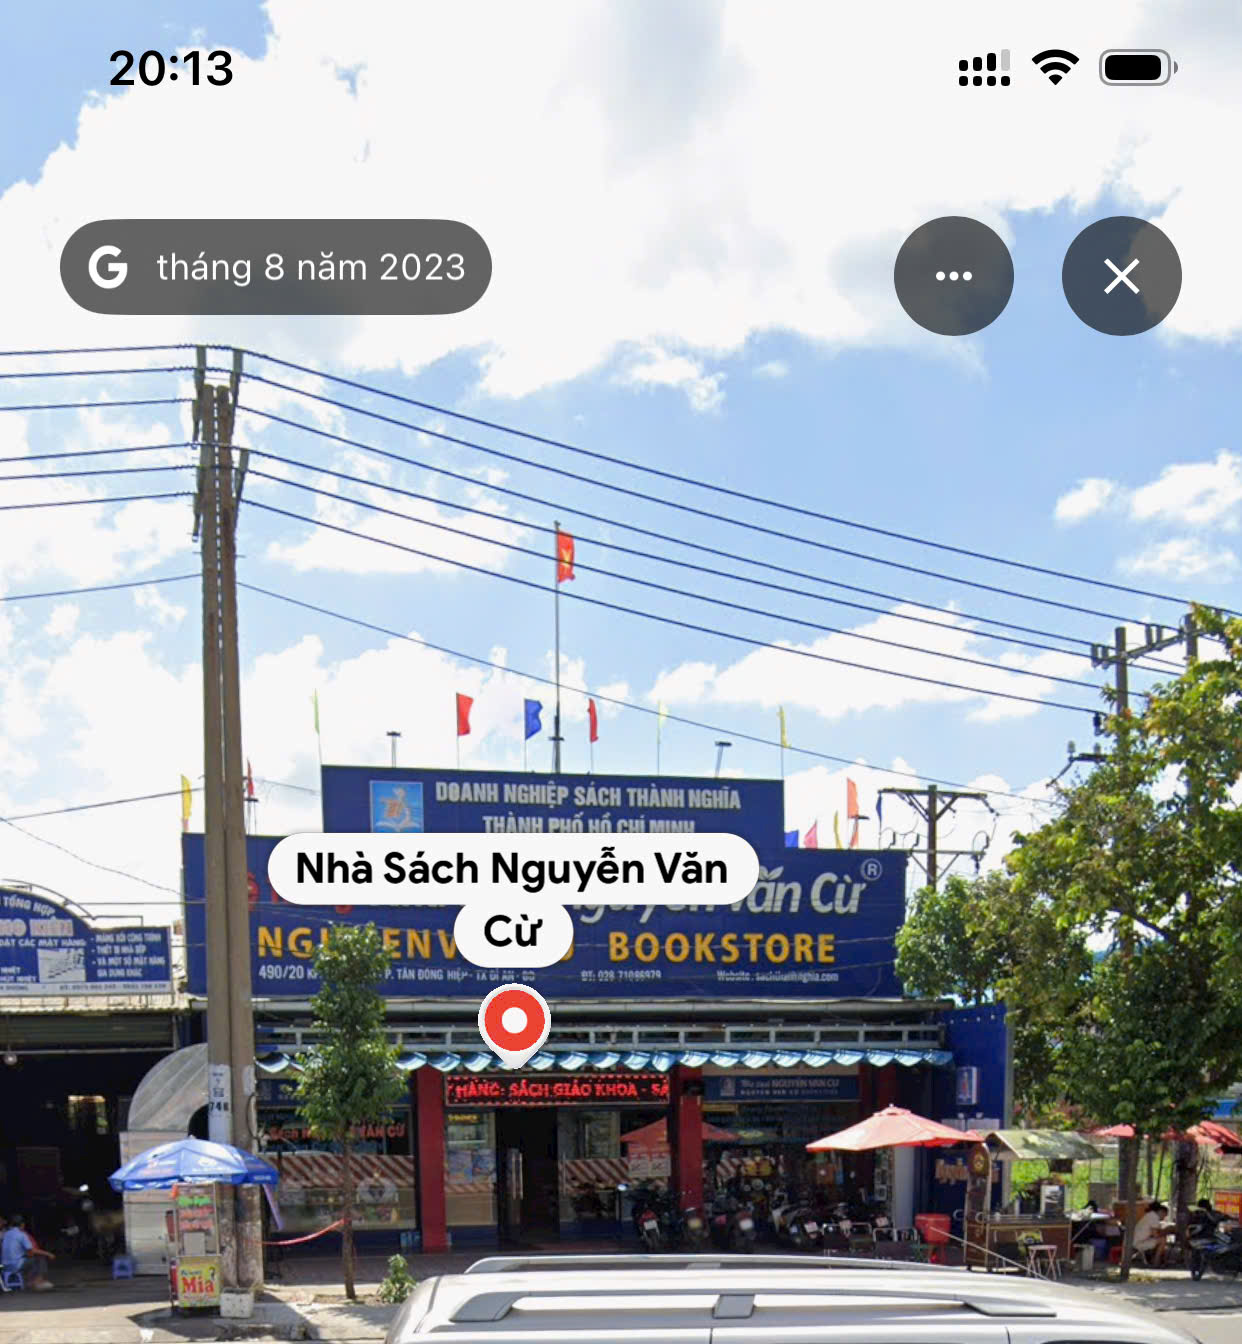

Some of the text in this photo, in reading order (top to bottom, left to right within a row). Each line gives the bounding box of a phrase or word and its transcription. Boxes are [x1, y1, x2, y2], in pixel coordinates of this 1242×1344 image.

[435, 780, 741, 809] DOANH NGHIỆP SÁCH THÀNH NGHĨA
[482, 811, 695, 833] THÀNH PHỐ HỒ CHÍ MINH
[810, 872, 868, 914] Cừ
[609, 931, 836, 963] BOOKSTORE
[258, 965, 304, 979] 490/20
[396, 967, 415, 980] TÂN
[418, 967, 443, 980] ĐÔNG
[510, 1080, 549, 1097] SÁCH
[553, 1080, 592, 1096] GIÁO
[594, 1083, 637, 1097] KHOA
